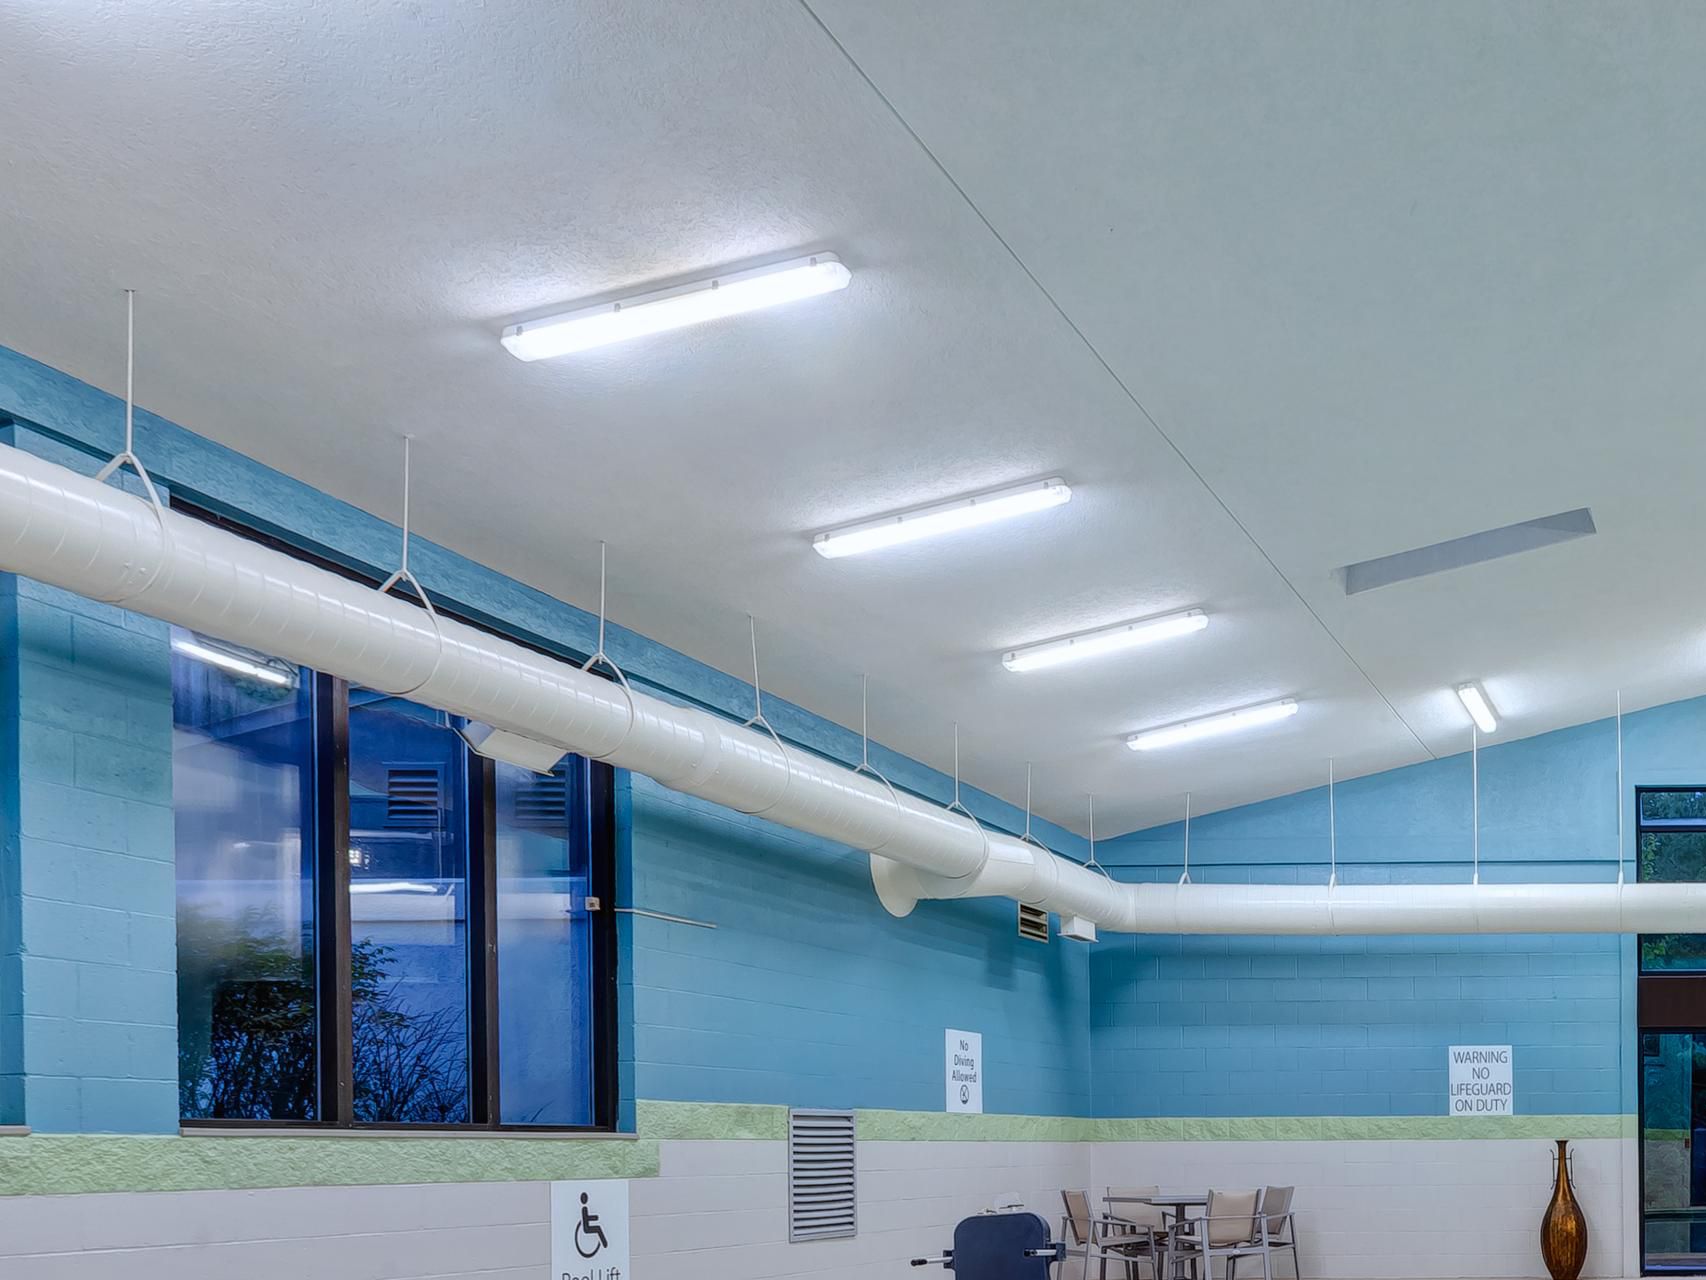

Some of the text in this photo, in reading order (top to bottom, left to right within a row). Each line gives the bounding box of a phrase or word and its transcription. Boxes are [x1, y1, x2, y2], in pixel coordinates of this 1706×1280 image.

[959, 1040, 969, 1051] No
[953, 1053, 975, 1070] Diving
[1453, 1050, 1508, 1064] WARNING
[952, 1069, 977, 1083] Allowed
[1472, 1066, 1490, 1080] NO
[1450, 1082, 1512, 1096] LIFEGUARD
[1455, 1098, 1508, 1112] ON DUTY
